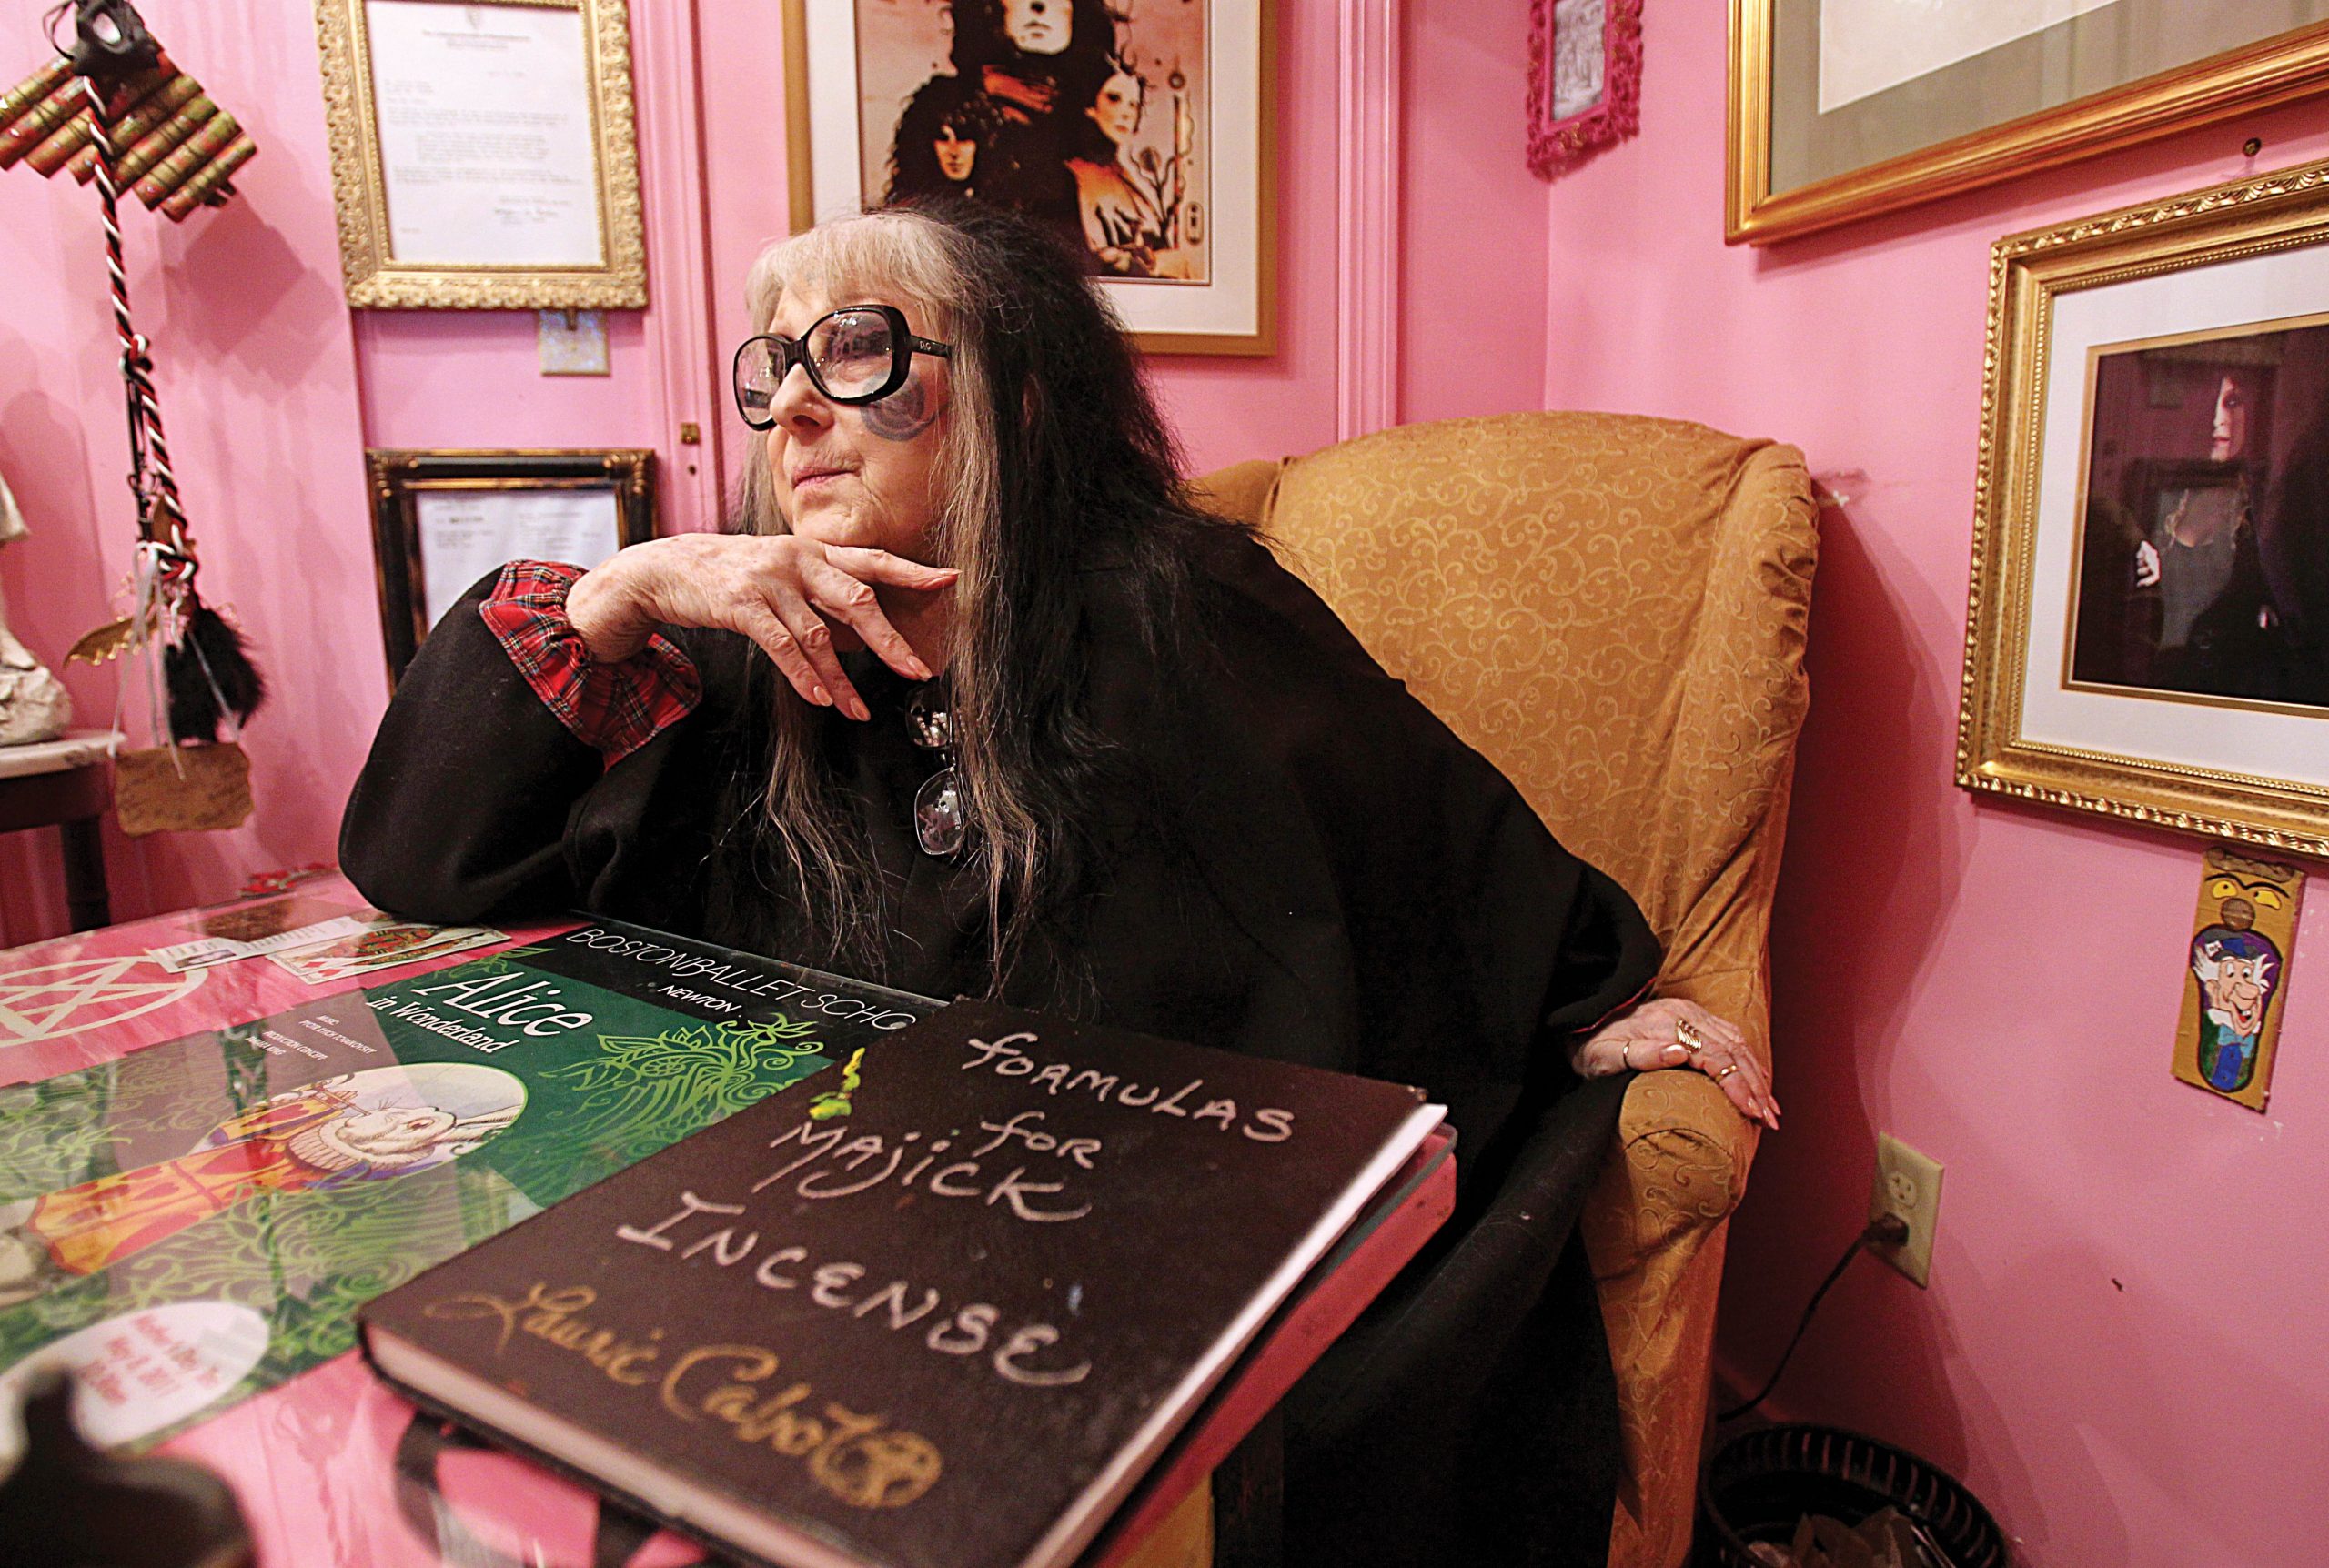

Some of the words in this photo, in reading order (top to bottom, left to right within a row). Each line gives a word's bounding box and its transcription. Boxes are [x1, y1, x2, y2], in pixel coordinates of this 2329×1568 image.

[366, 995, 398, 1010] in
[389, 1000, 520, 1054] Wonderland
[410, 971, 593, 1037] Alice
[658, 984, 740, 1013] NEWTON
[617, 1191, 1090, 1385] INCENSE
